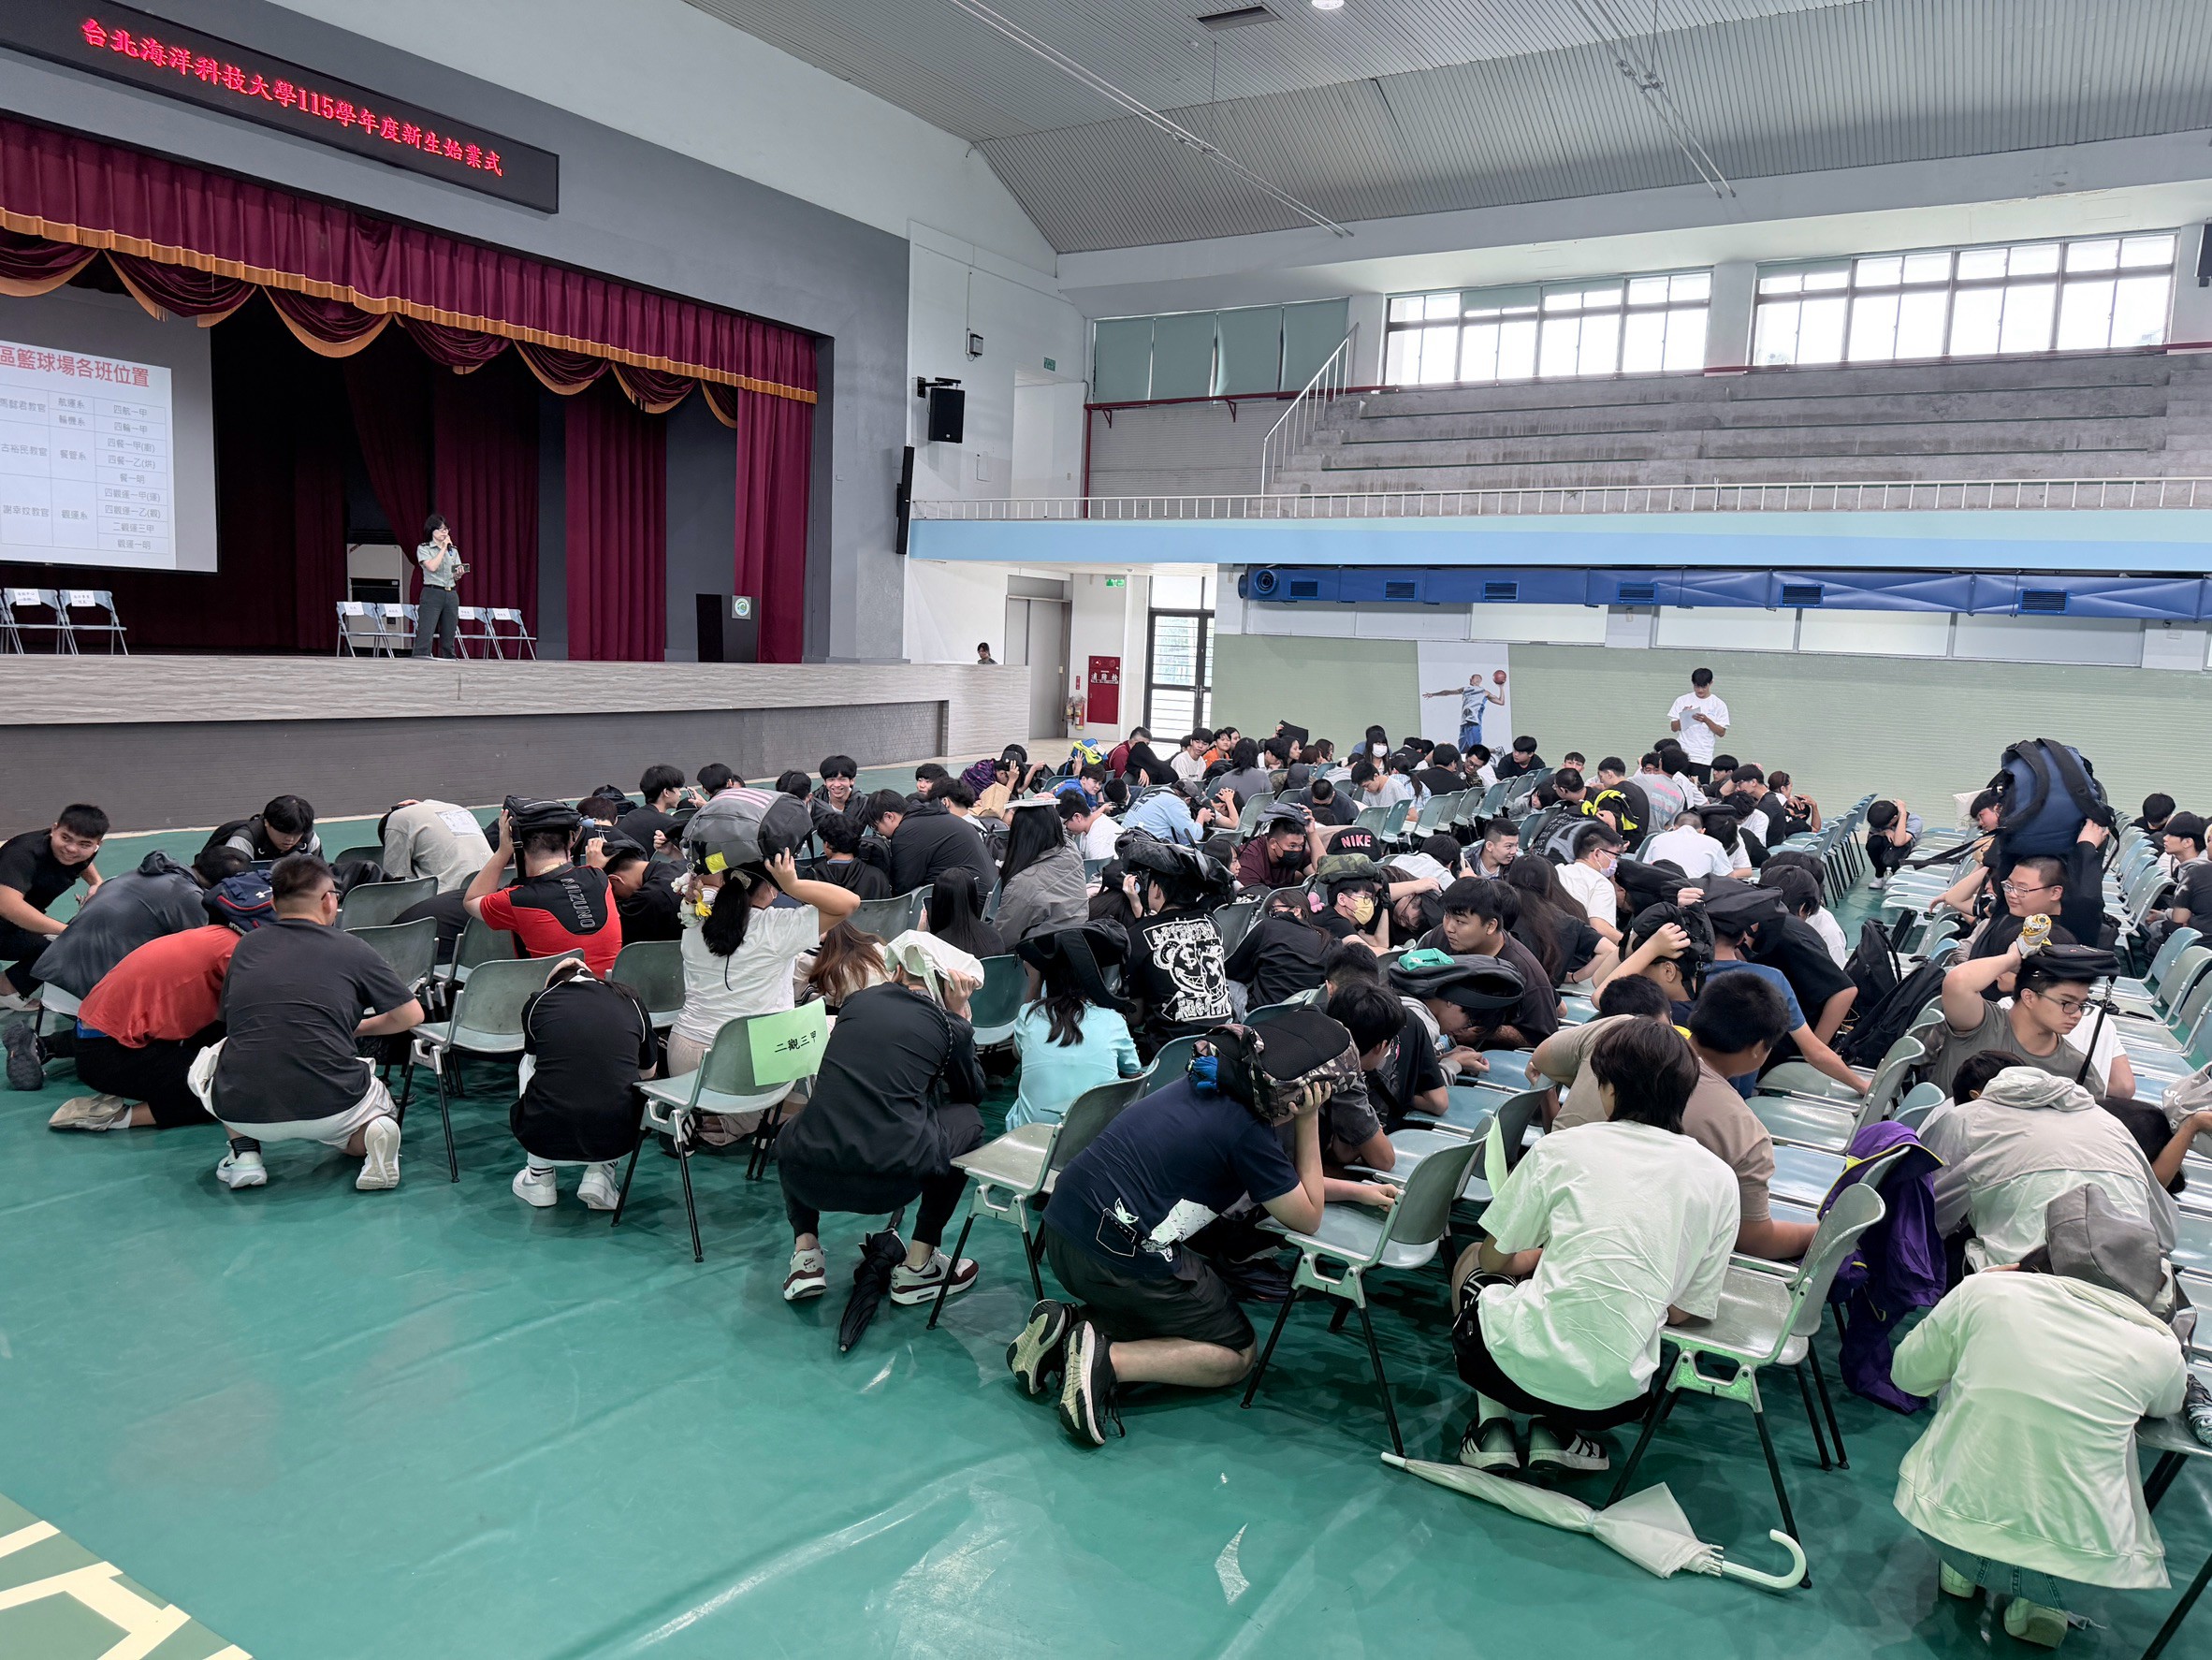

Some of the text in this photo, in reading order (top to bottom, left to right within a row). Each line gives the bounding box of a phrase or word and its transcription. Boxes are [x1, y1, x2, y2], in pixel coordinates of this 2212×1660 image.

[81, 18, 503, 177] 台北海洋科技大學115學年度新生始業式
[1341, 834, 1372, 849] NIKE
[560, 878, 596, 928] MIZUNO
[775, 1030, 817, 1053] 二觀三甲
